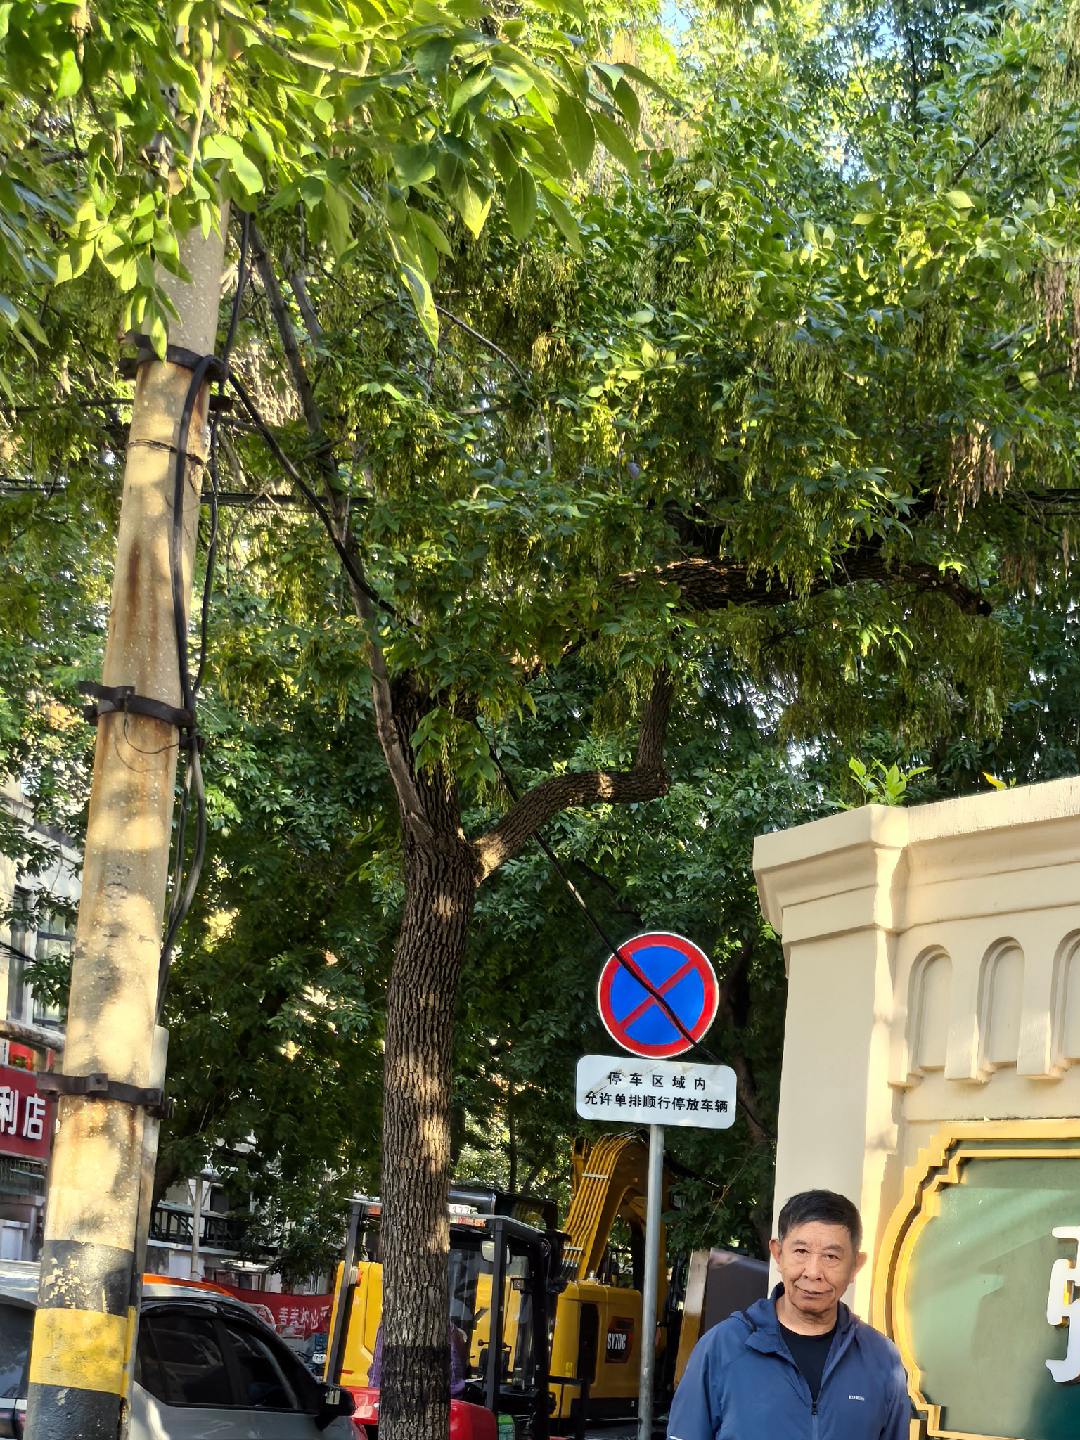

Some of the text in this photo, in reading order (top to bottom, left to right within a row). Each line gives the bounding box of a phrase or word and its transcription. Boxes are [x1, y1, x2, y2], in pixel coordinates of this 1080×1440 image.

[608, 1071, 706, 1091] 停车区域内
[585, 1091, 729, 1113] 允许单排顺行停放车辆
